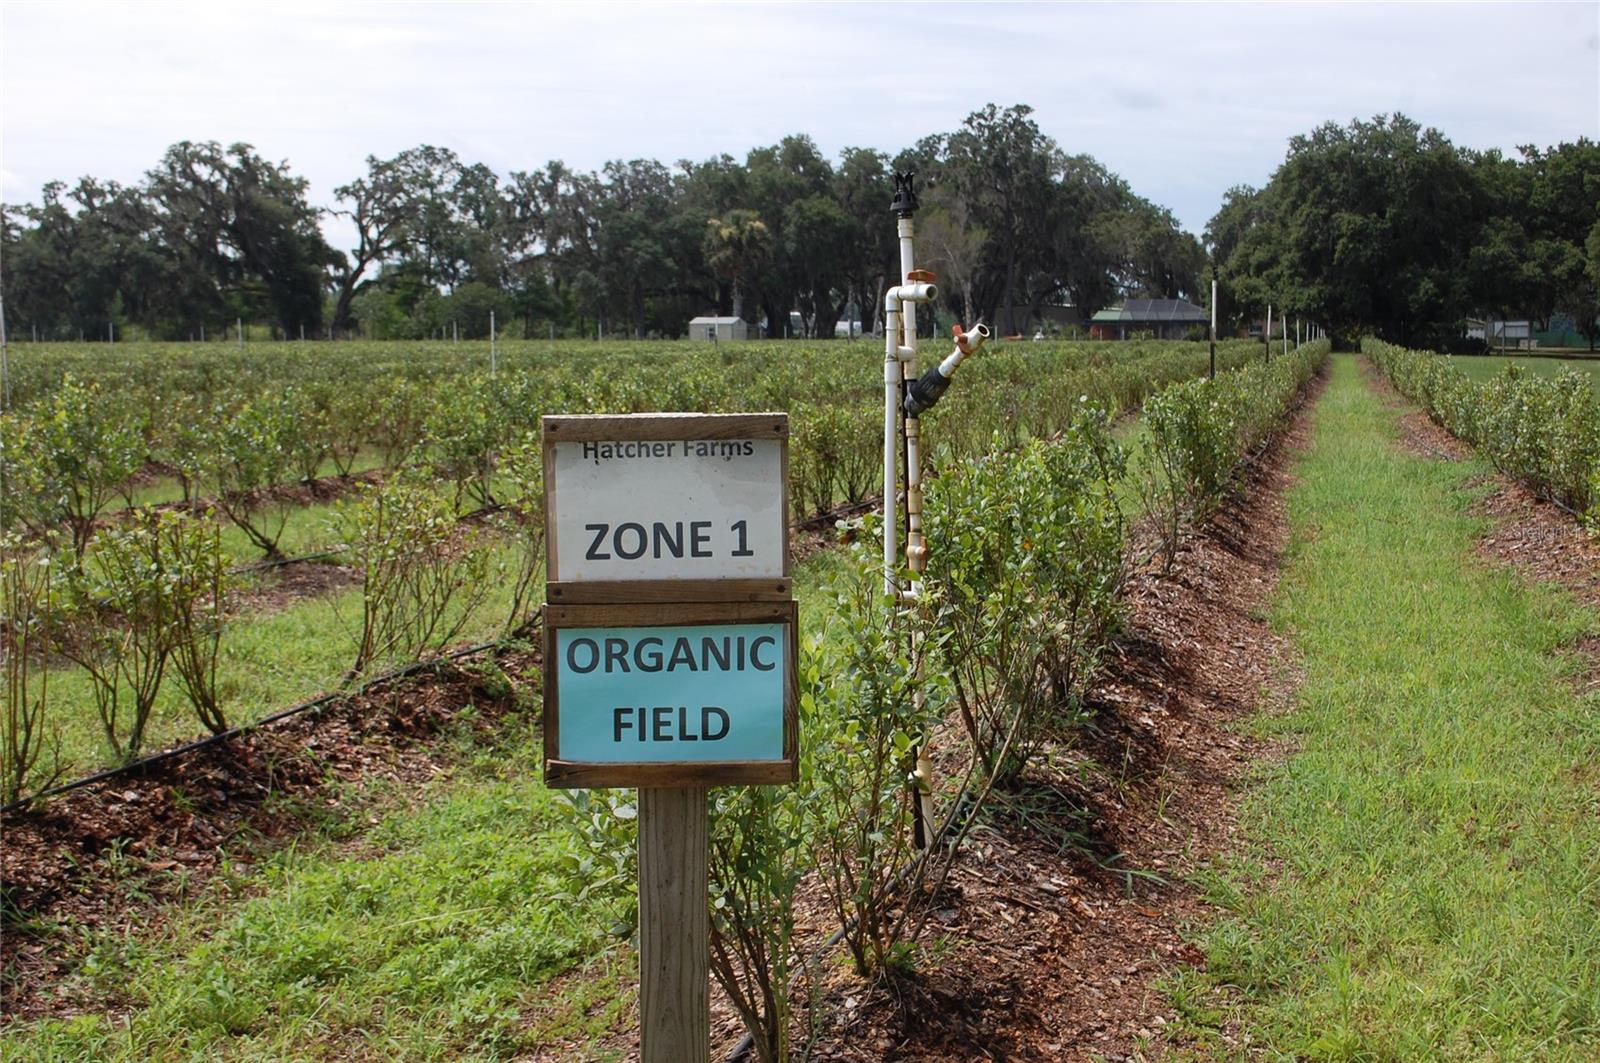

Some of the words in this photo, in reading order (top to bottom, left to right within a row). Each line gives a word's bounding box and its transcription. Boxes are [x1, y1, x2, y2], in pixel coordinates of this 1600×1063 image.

[583, 440, 676, 459] Hatcher
[684, 440, 754, 457] Farms
[585, 521, 713, 560] ZONE
[730, 519, 754, 557] 1
[566, 636, 776, 674] ORGANIC
[613, 707, 731, 742] FIELD
